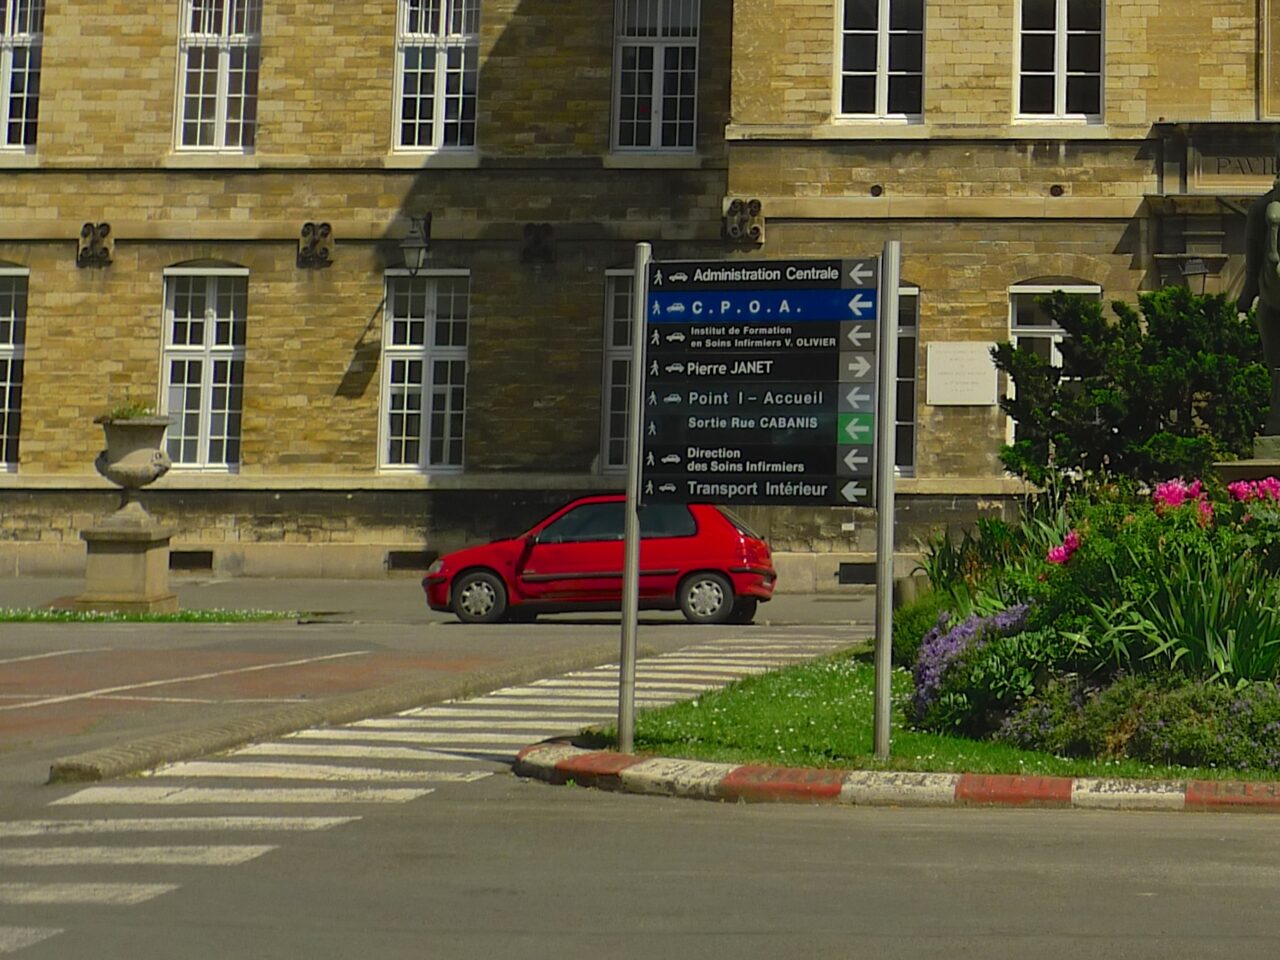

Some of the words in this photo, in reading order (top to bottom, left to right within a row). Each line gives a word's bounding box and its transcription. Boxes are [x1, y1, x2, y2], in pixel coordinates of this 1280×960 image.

[693, 268, 781, 281] Administration
[786, 266, 839, 280] Centrale
[691, 327, 725, 335] Institut
[728, 327, 740, 335] de
[743, 326, 791, 335] Formation
[735, 339, 781, 347] Infirmiers
[785, 339, 793, 347] V.
[796, 338, 836, 347] OLIVIER
[687, 362, 726, 375] Pierre
[730, 361, 773, 374] JANET
[689, 392, 728, 404] Point
[764, 391, 823, 404] Accueil
[688, 417, 726, 428] Sortie
[732, 417, 755, 428] Rue
[760, 417, 818, 428] CABANIS
[687, 448, 741, 458] Direction
[687, 461, 707, 471] des
[711, 461, 743, 472] Soins
[746, 461, 804, 472] Infirmiers
[687, 481, 758, 498] Transport
[766, 481, 827, 495] Intérieur
